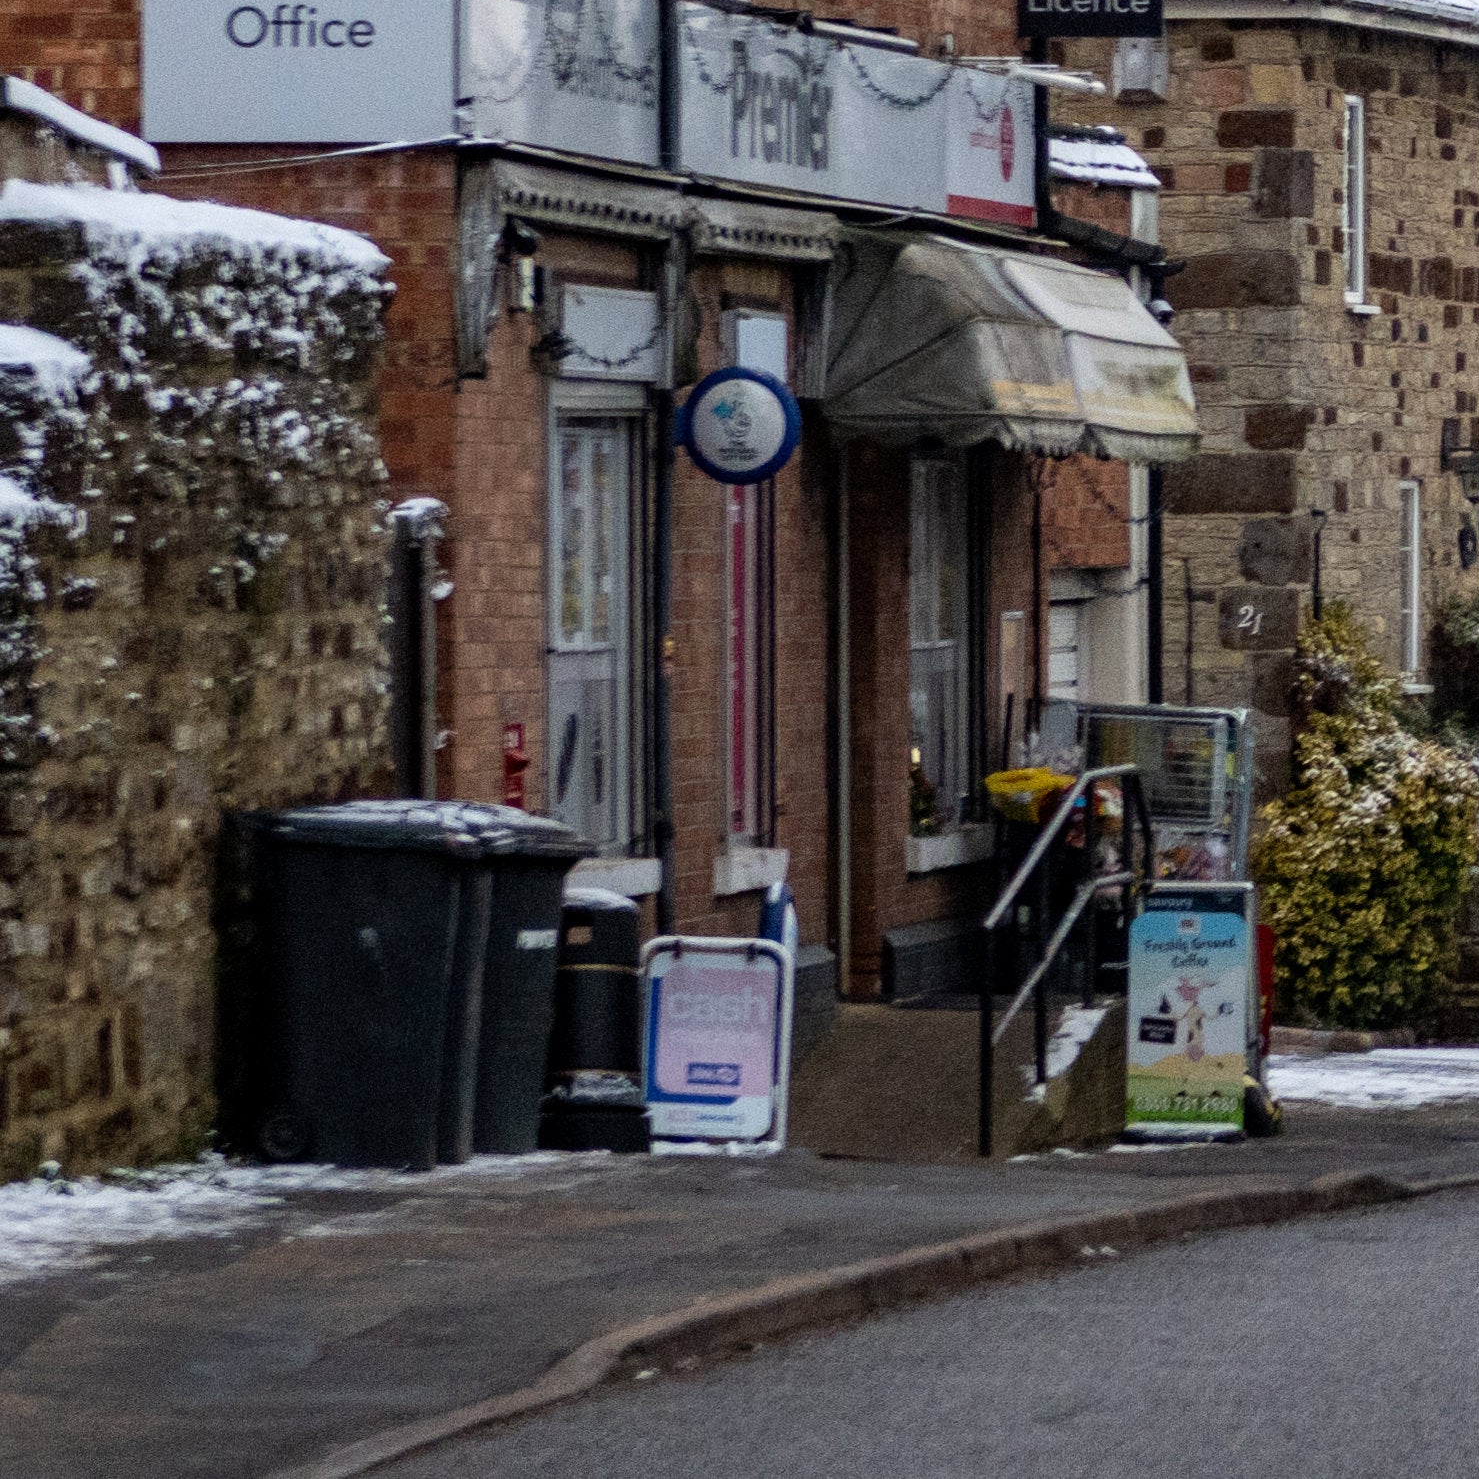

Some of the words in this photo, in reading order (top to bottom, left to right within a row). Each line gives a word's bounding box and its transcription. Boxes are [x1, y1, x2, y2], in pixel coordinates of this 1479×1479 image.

[226, 4, 376, 48] Office
[731, 40, 833, 170] Premier
[1237, 604, 1264, 635] 21
[666, 986, 768, 1023] cash
